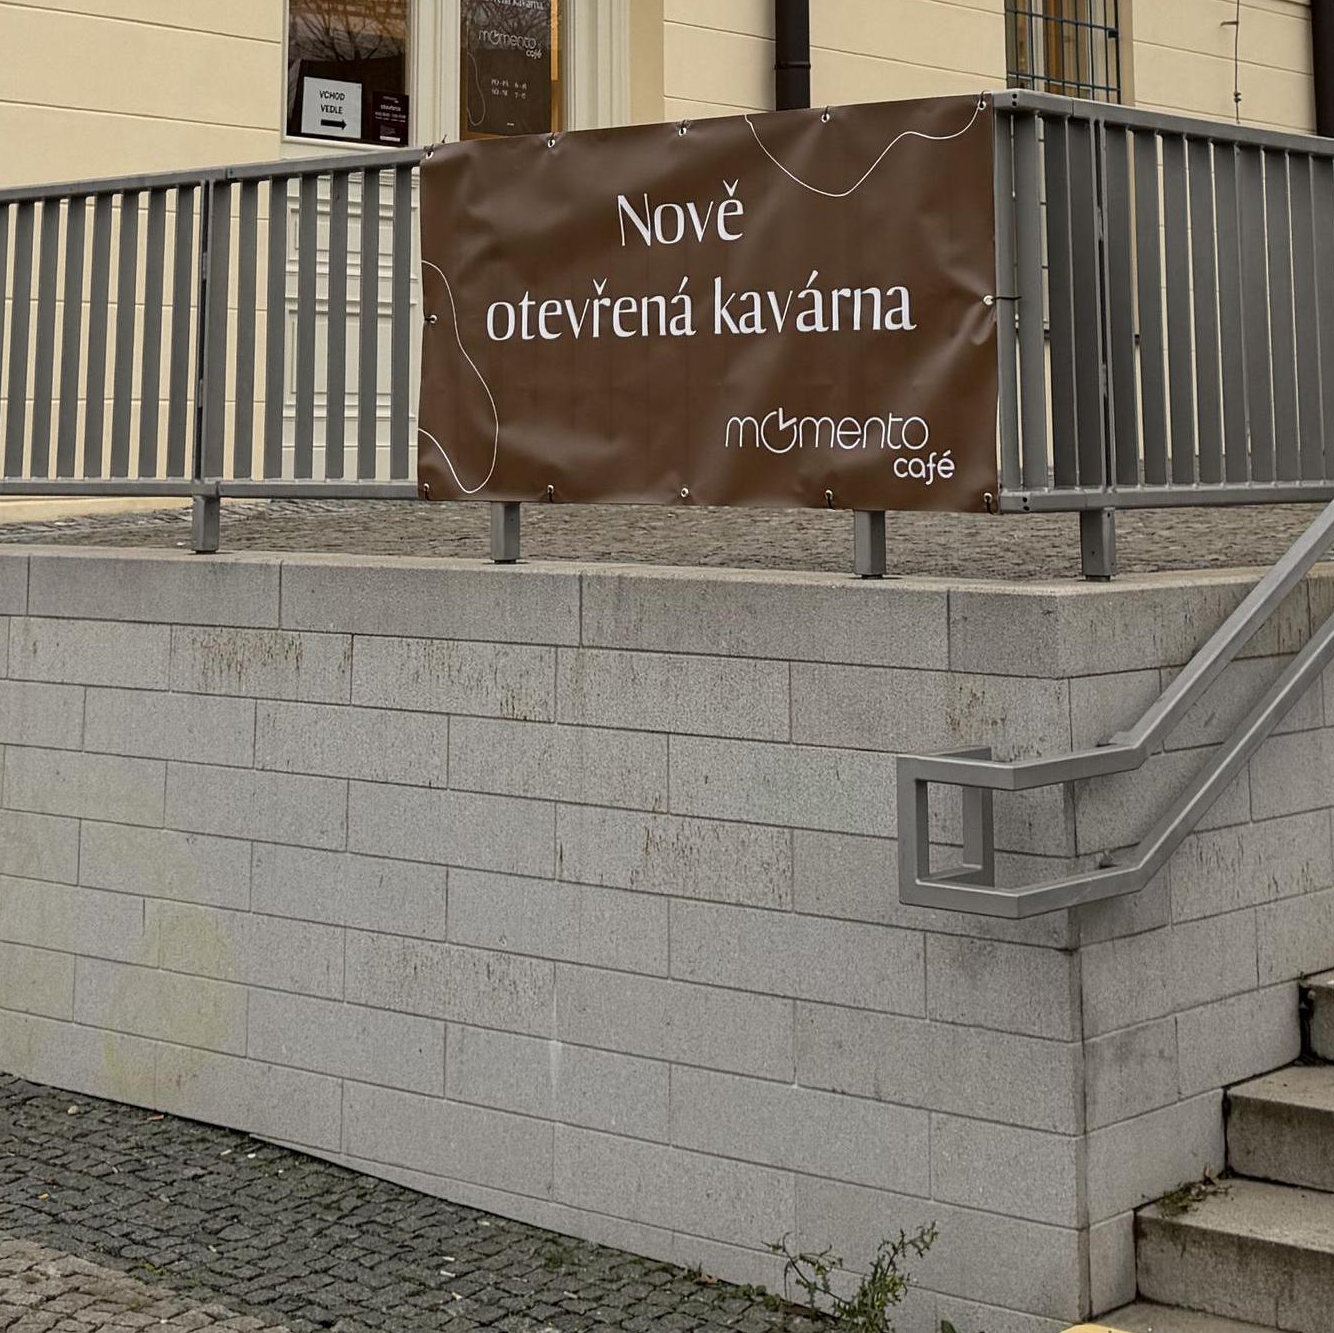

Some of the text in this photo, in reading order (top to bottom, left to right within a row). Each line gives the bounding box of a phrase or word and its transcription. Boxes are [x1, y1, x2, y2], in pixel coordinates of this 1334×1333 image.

[319, 90, 345, 101] VCHOD
[320, 104, 343, 115] VEDLE
[617, 179, 744, 246] Nově
[486, 270, 917, 341] otevřená kavárna
[725, 407, 929, 454] momento
[893, 450, 955, 486] café
